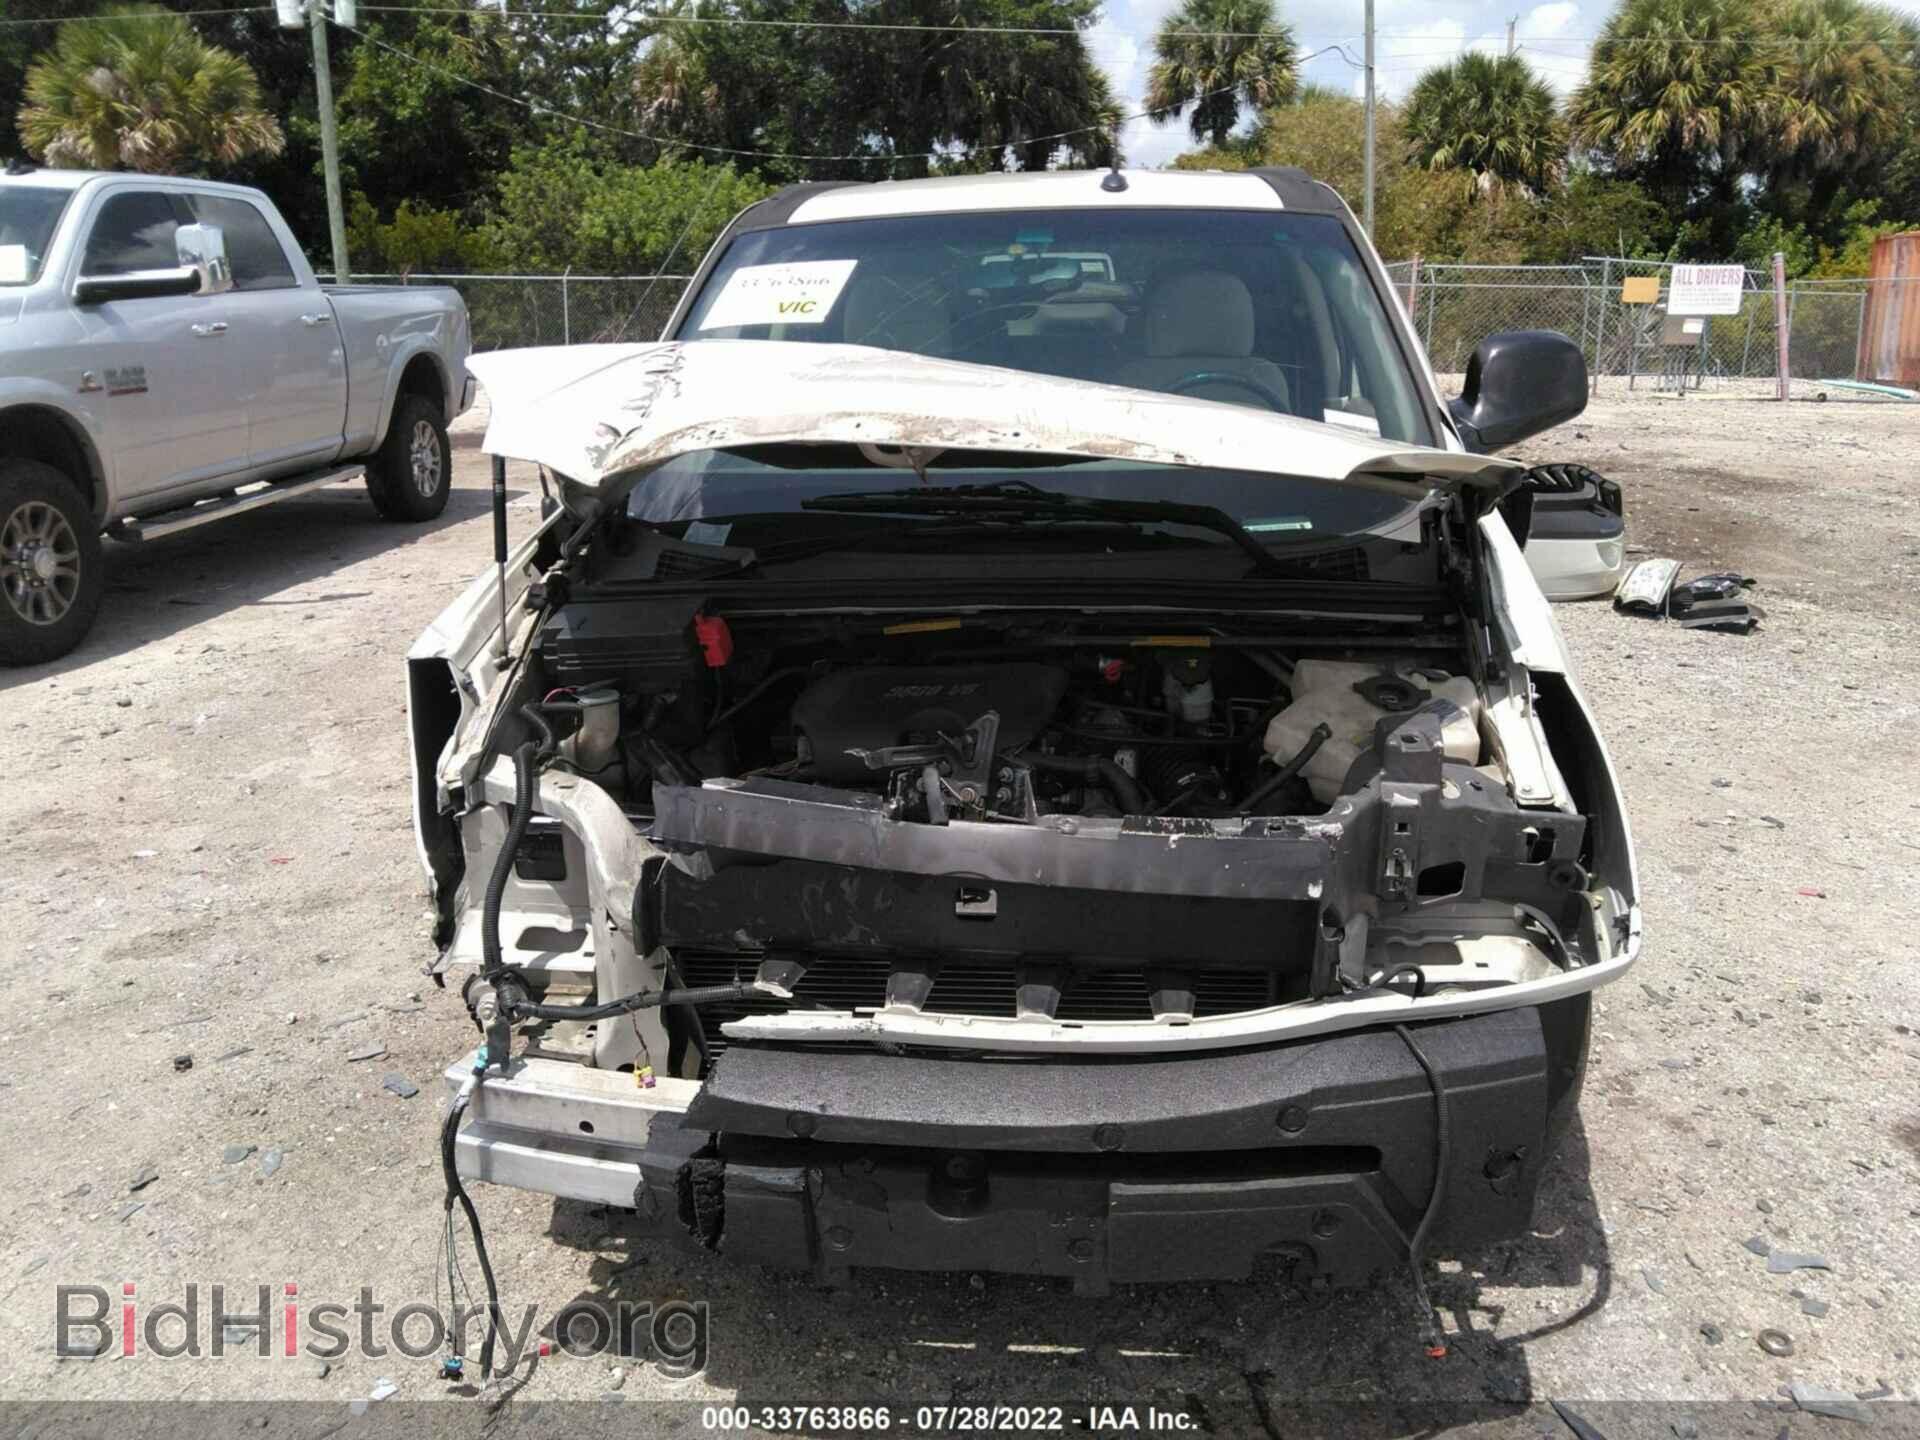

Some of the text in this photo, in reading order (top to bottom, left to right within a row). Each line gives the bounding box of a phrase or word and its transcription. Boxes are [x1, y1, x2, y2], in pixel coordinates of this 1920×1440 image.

[1674, 268, 1741, 286] ALL DRIVERS
[778, 301, 817, 314] VIC
